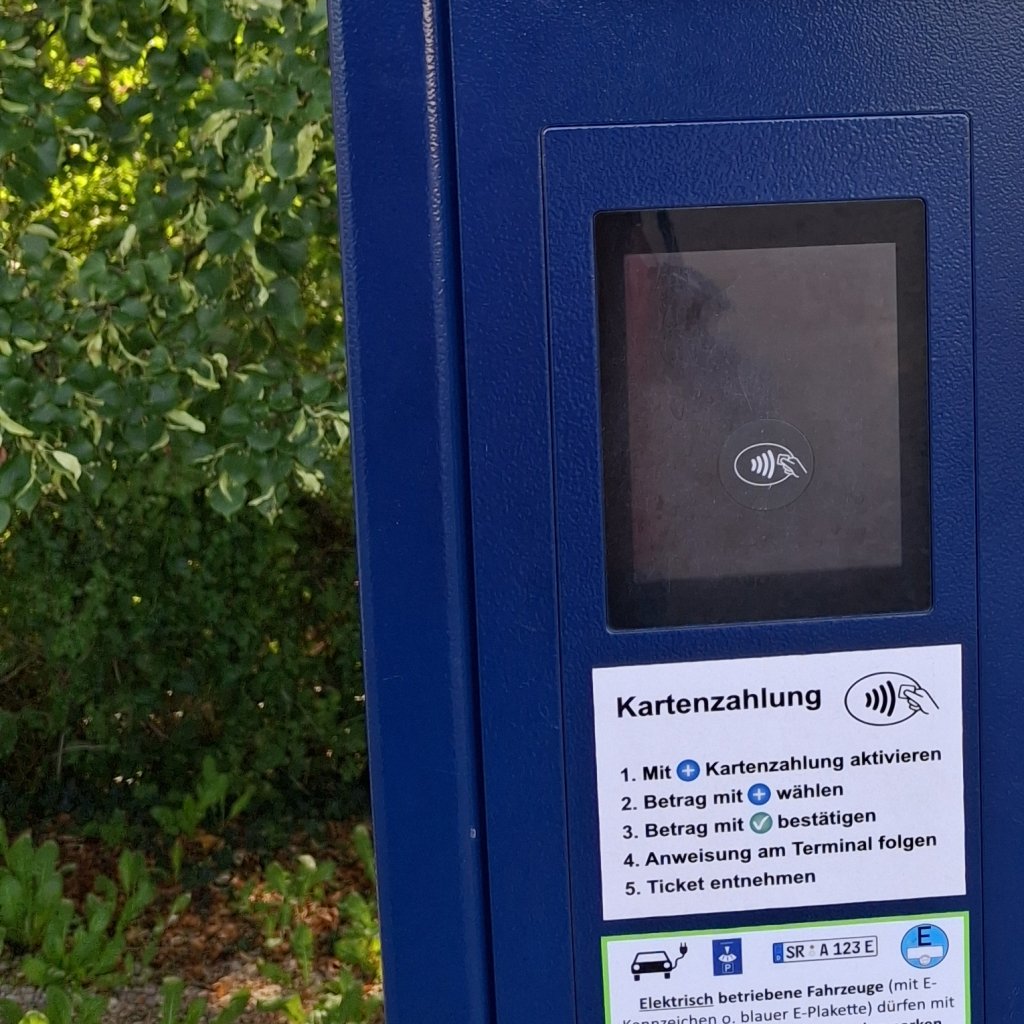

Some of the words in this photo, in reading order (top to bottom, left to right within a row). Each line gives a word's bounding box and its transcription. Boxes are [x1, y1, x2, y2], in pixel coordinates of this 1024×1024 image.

[617, 687, 822, 718] Kartenzahlung
[620, 768, 636, 782] 1.
[642, 766, 672, 781] Mit
[705, 754, 844, 777] Kartenzahlung
[850, 747, 942, 766] aktivieren
[621, 797, 637, 811] 2.
[644, 792, 707, 811] Betrag
[713, 788, 744, 805] mit
[776, 785, 844, 800] wählen
[622, 825, 638, 839] 3.
[645, 820, 708, 839] Betrag
[714, 817, 745, 833] mit
[777, 809, 876, 829] bestätigen
[623, 853, 640, 867] 4.
[645, 846, 751, 867] Anweisung
[758, 844, 786, 858] am
[792, 837, 873, 856] Terminal
[878, 834, 937, 852] folgen
[624, 881, 641, 896] 5.
[647, 876, 705, 894] Ticket
[710, 870, 816, 890] entnehmen
[786, 945, 805, 959] SR
[819, 943, 829, 956] A
[833, 941, 861, 955] 123
[865, 940, 874, 953] E
[918, 926, 932, 947] E
[639, 993, 714, 1012] Elektrisch
[718, 986, 802, 1005] betriebene
[807, 982, 884, 997] Fahrzeuge
[889, 978, 918, 994] (mit
[923, 977, 937, 989] E-
[740, 1007, 789, 1023] blauer
[793, 1001, 872, 1020] E-Plakette)
[877, 997, 926, 1014] dürfen
[931, 996, 955, 1009] mit
